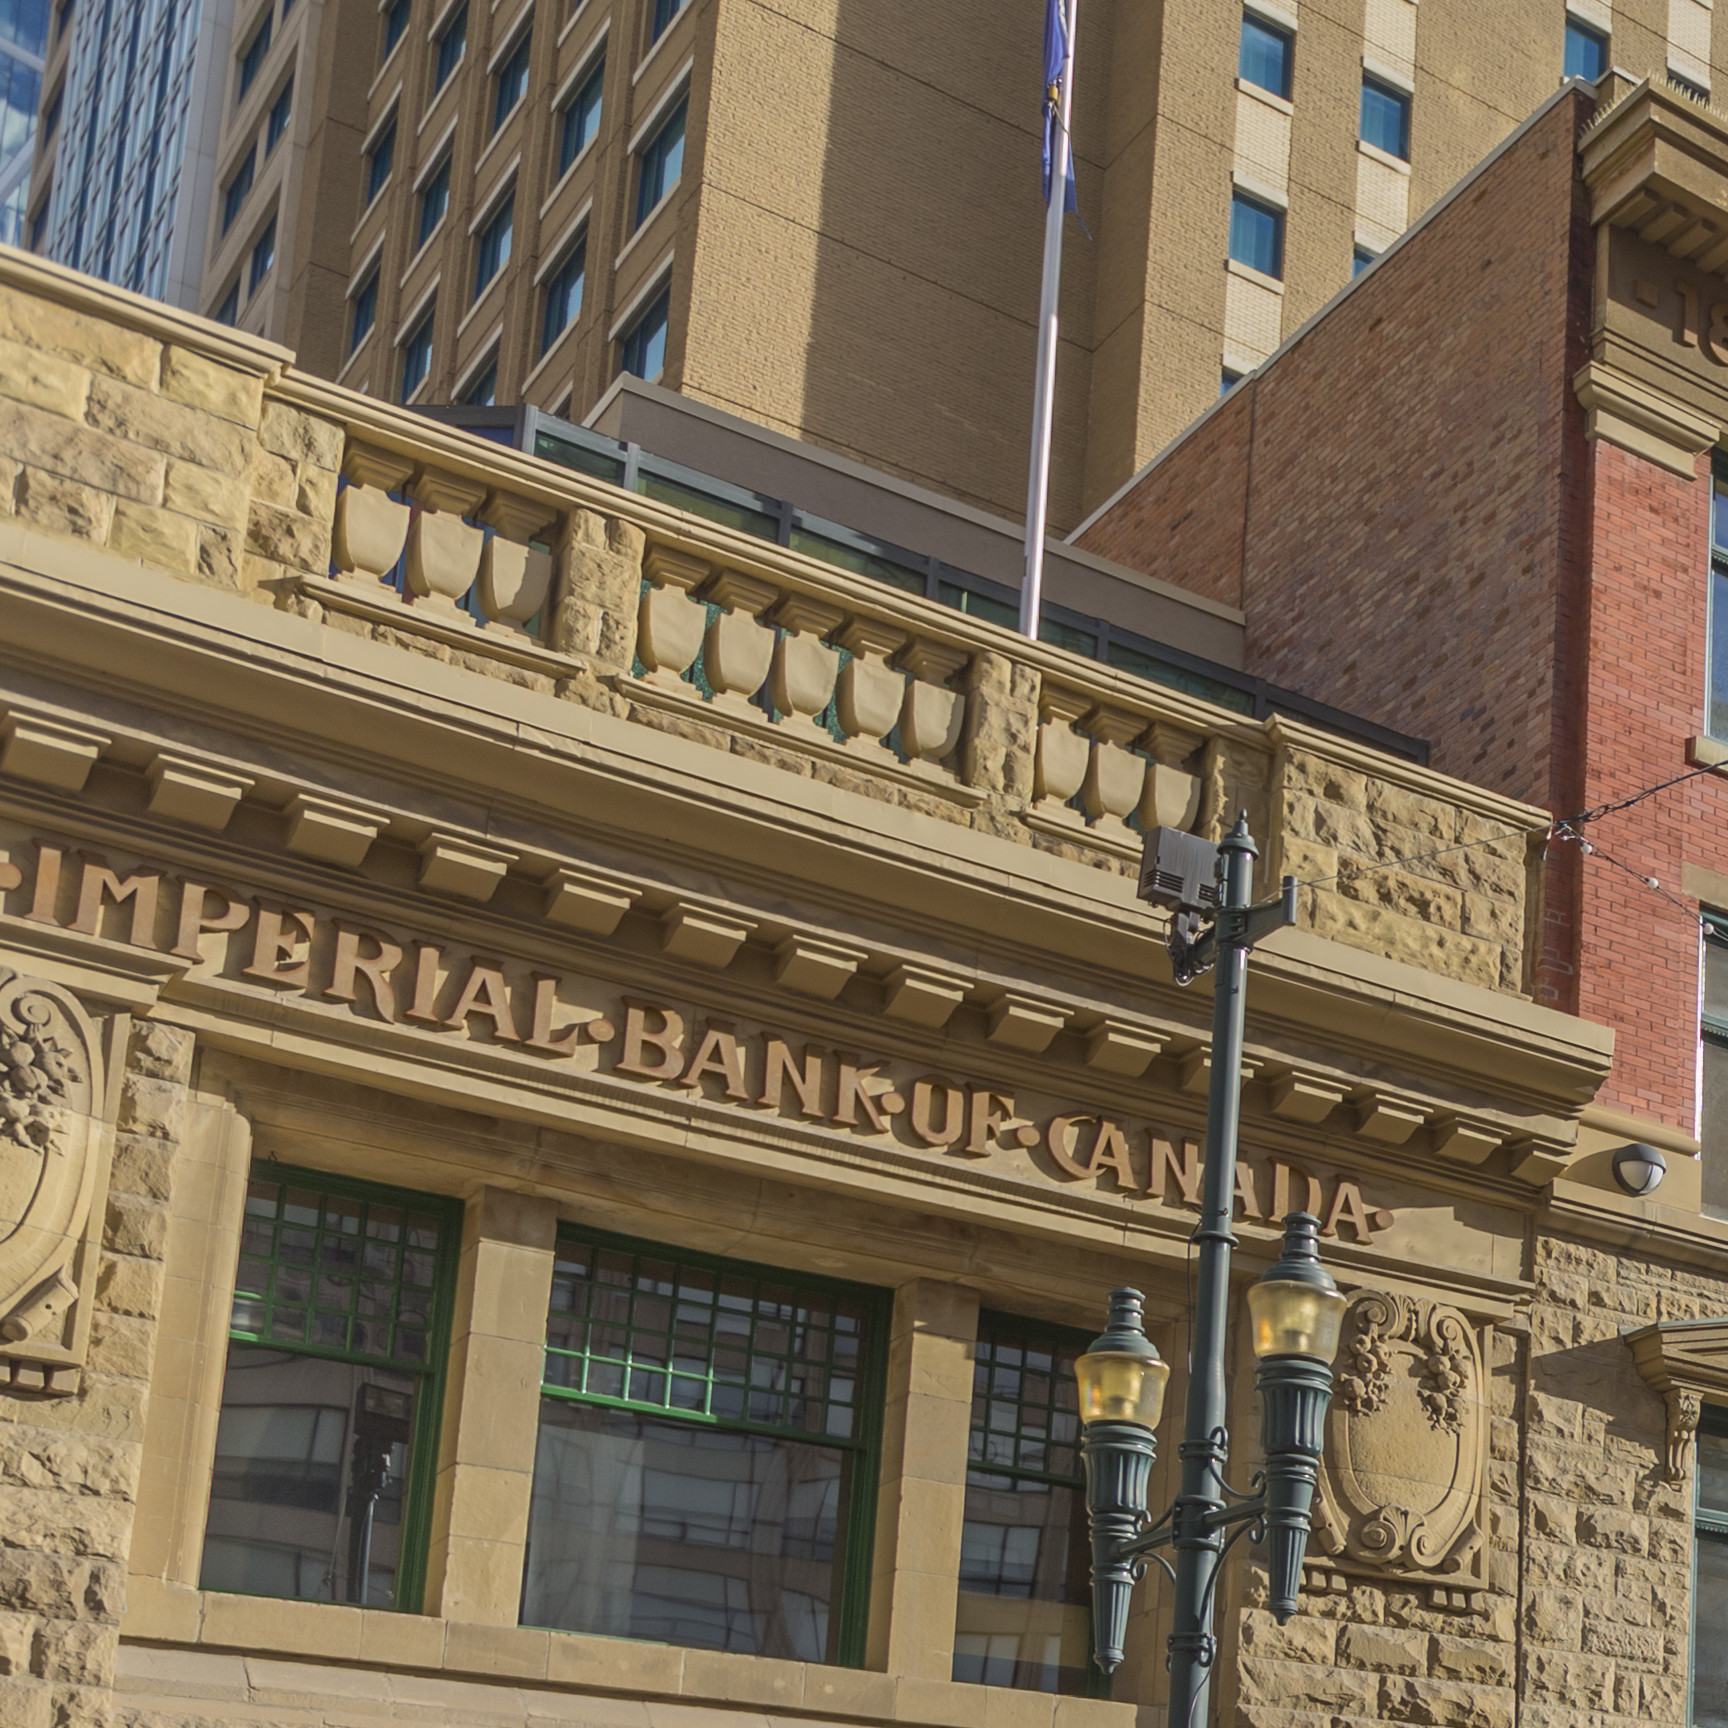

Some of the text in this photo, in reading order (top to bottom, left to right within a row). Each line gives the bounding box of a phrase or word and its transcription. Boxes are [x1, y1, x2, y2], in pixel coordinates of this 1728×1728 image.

[25, 838, 1377, 1245] IMPERIAL BANK OF CANADA
